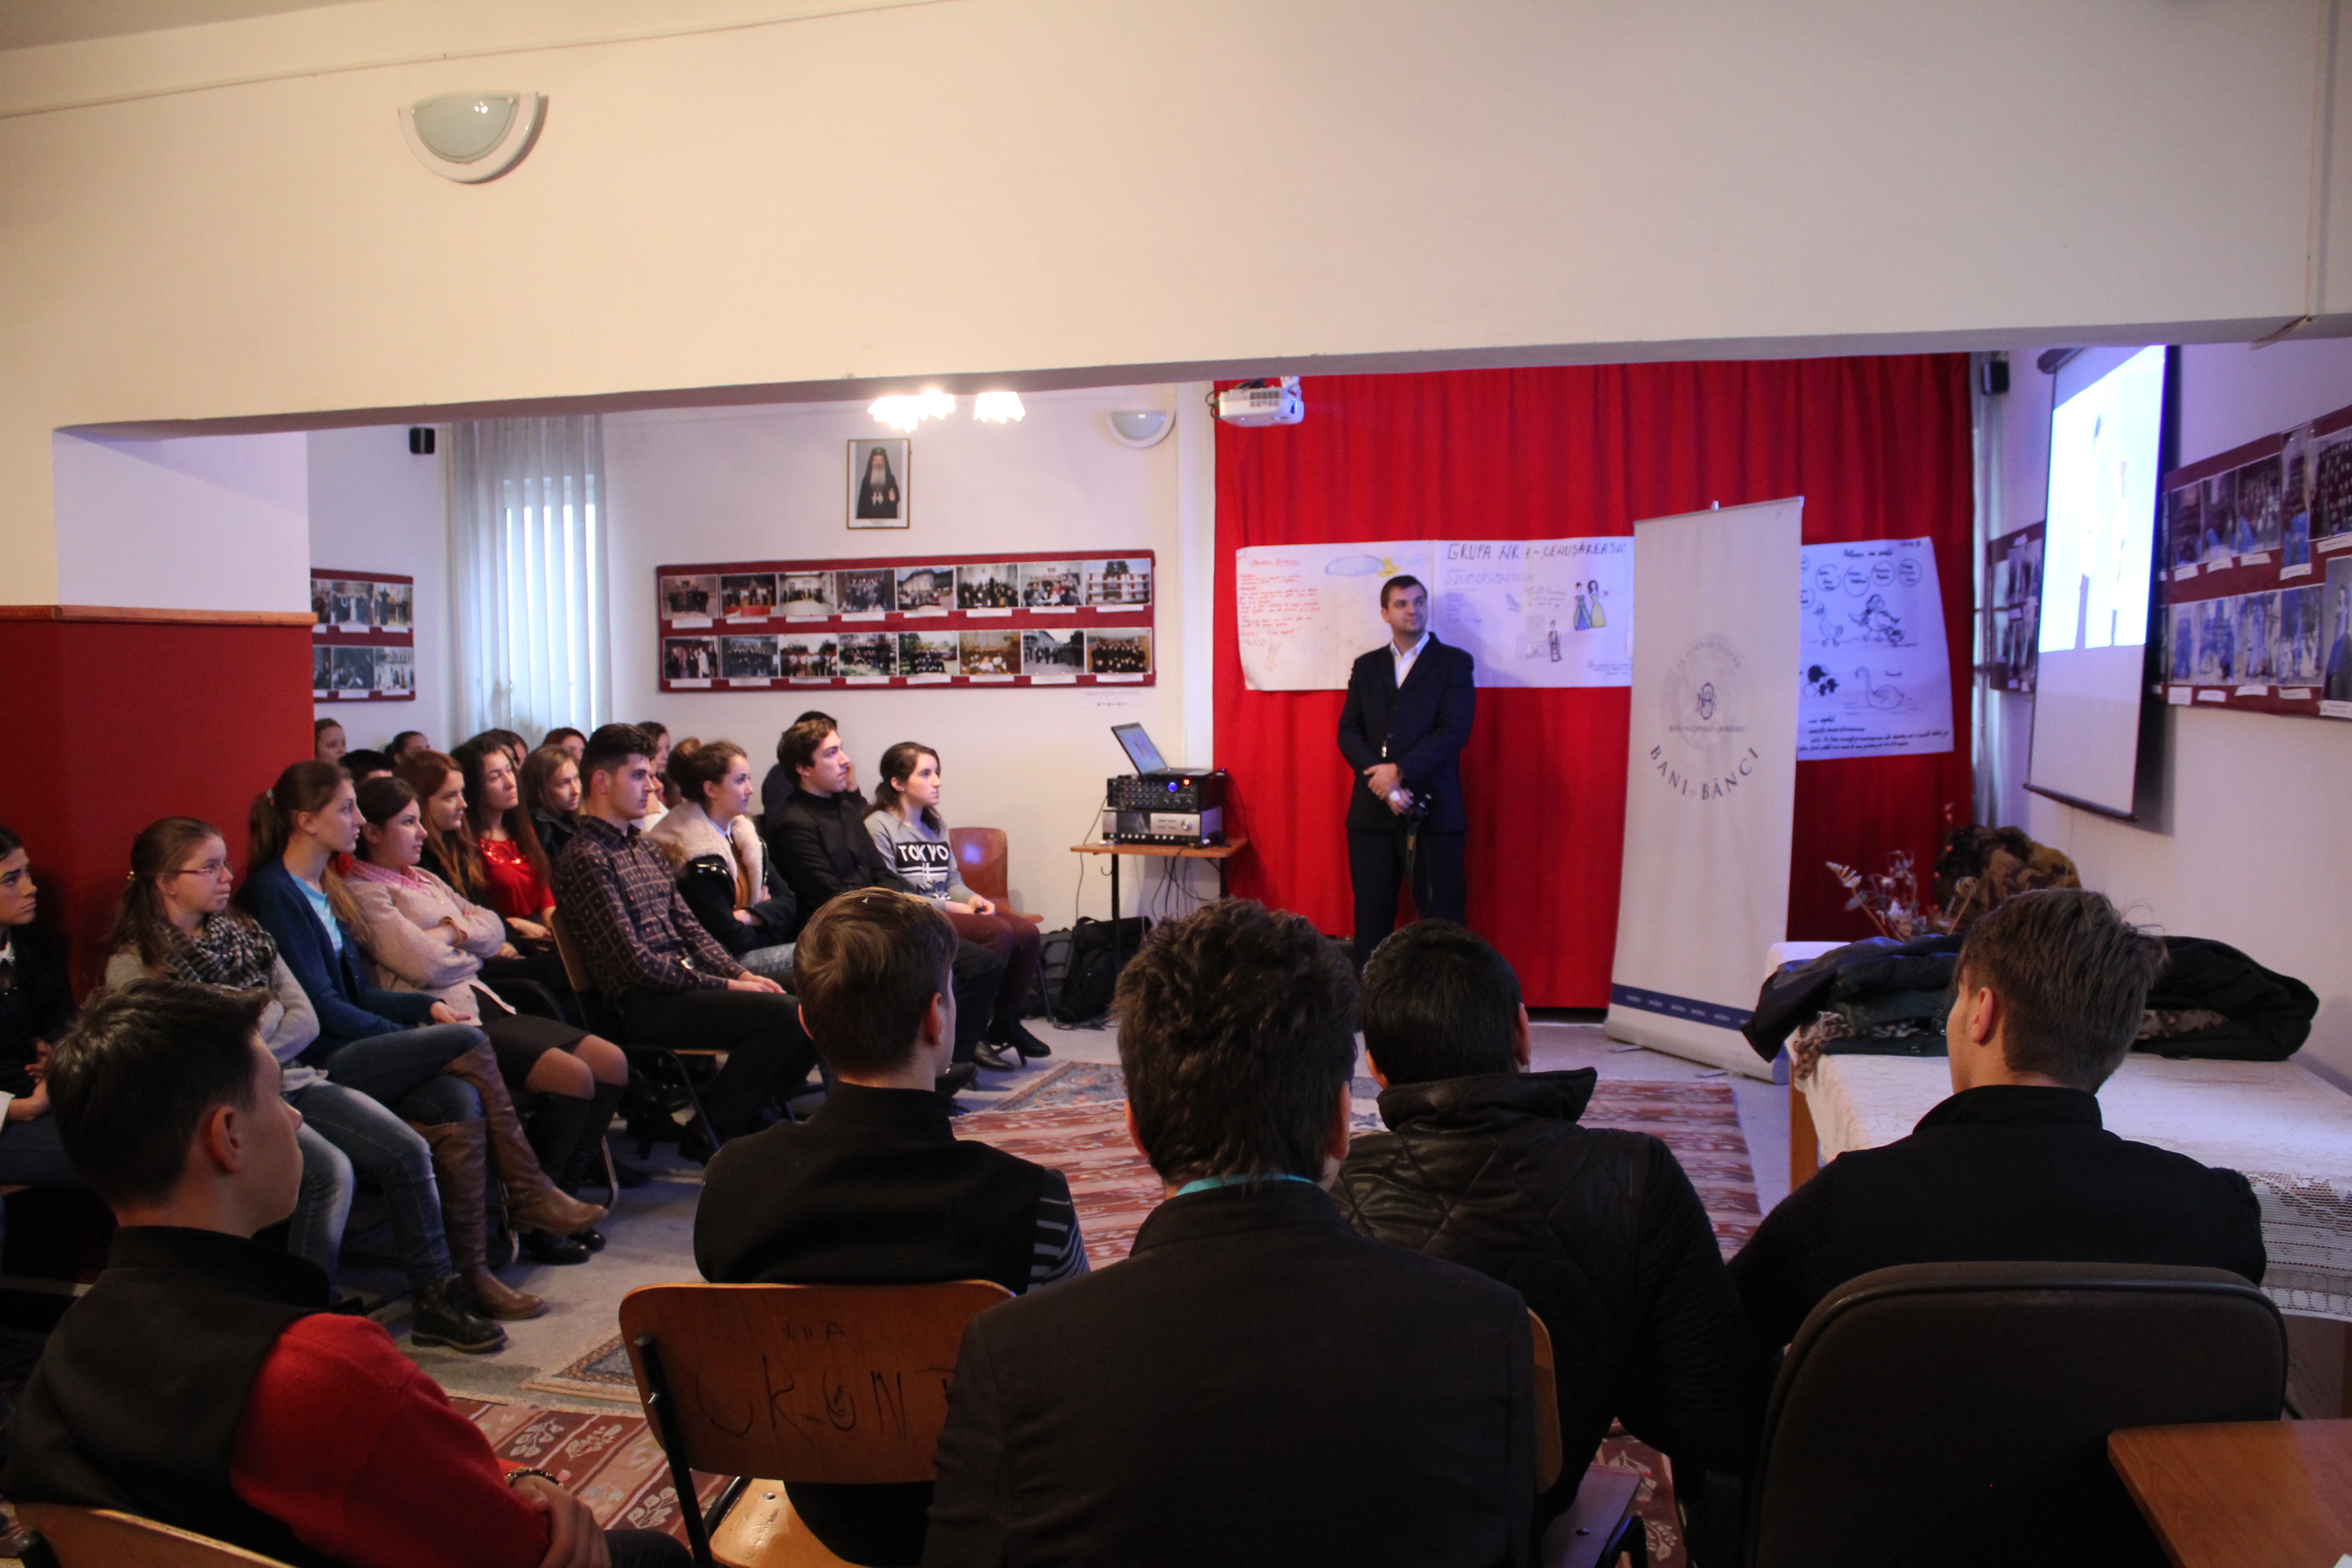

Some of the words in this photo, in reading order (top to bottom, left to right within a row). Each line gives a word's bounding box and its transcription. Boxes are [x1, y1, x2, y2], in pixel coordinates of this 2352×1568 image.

[1448, 543, 1491, 560] GRUPA
[1499, 544, 1520, 560] NR
[1650, 745, 1688, 795] BANI
[1702, 747, 1759, 800] BĂNCI
[898, 845, 949, 862] TOKYO
